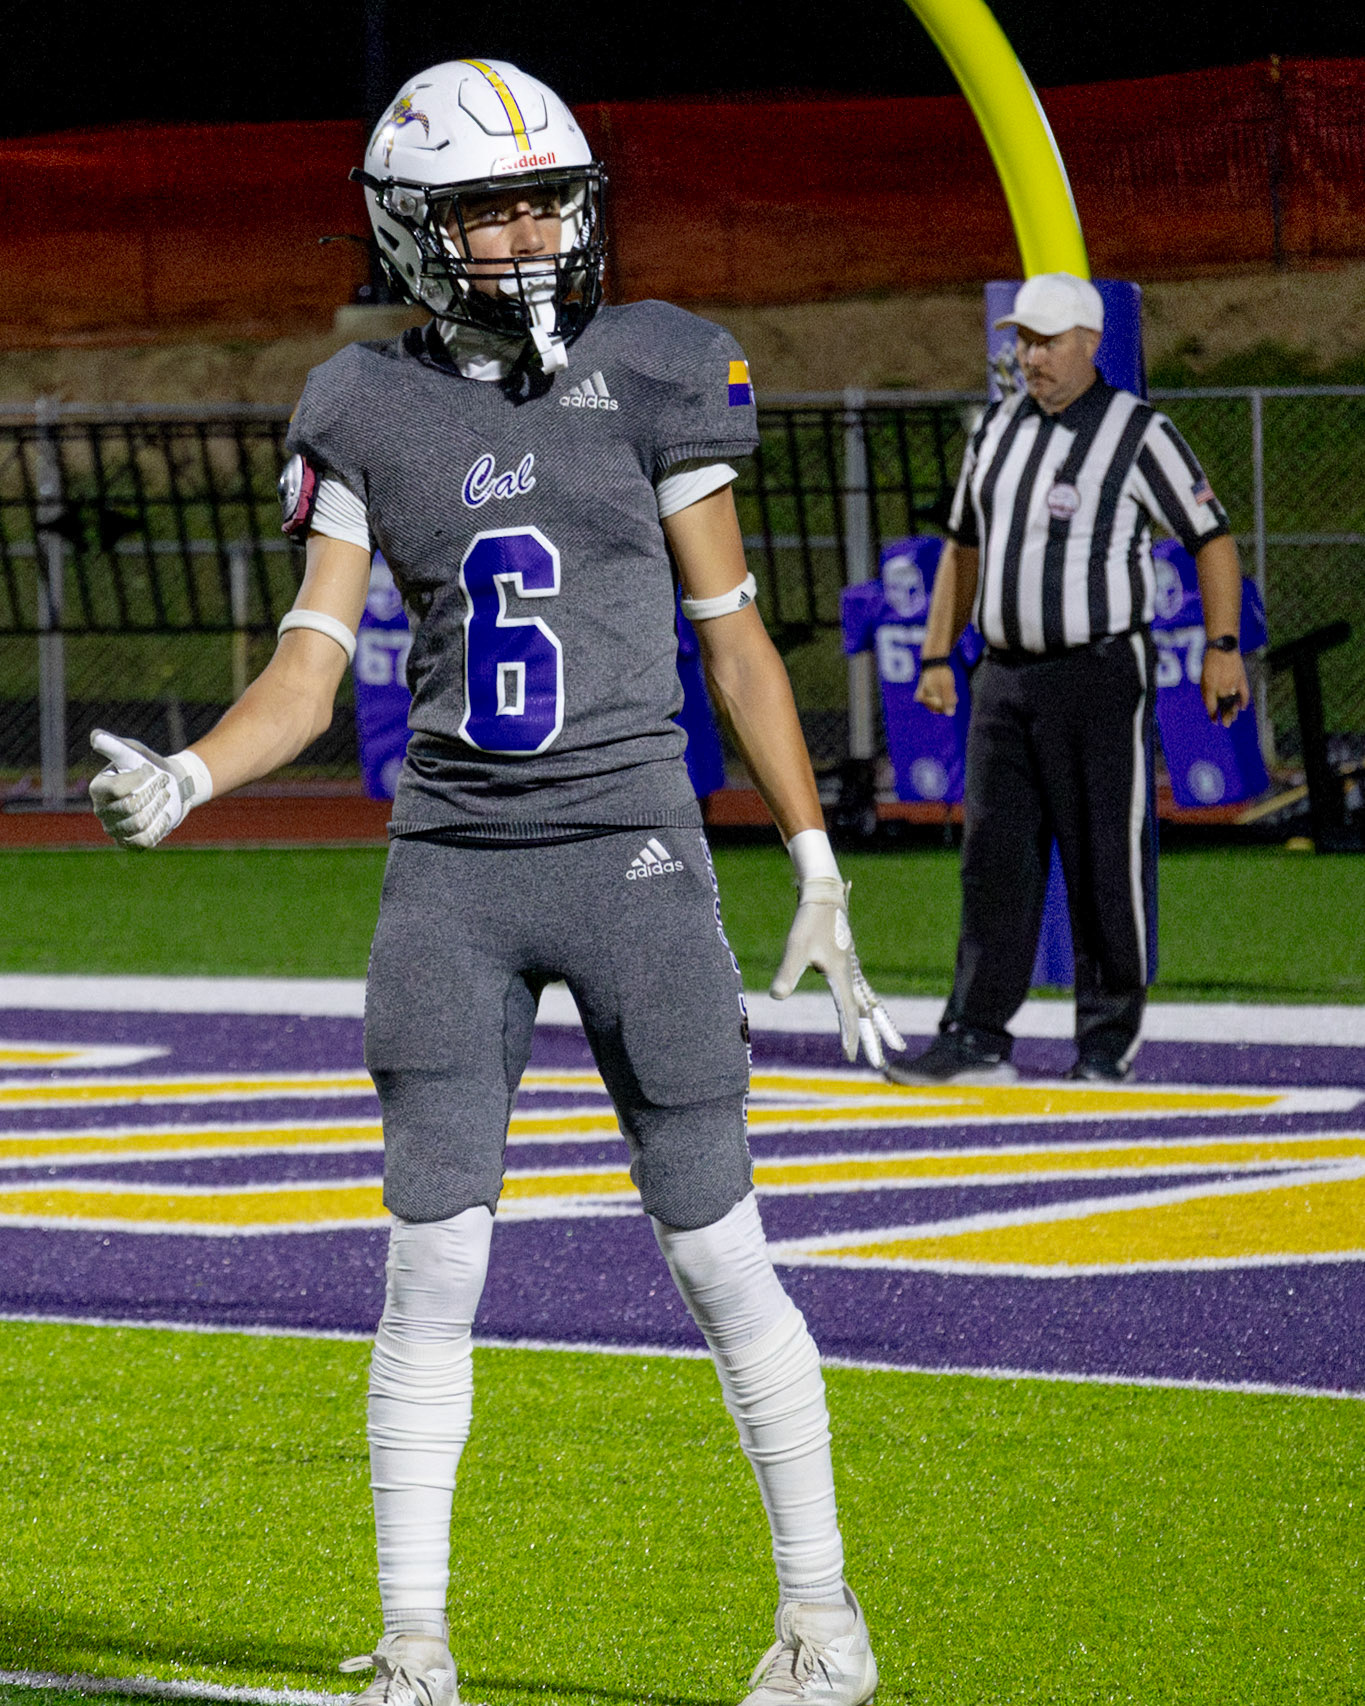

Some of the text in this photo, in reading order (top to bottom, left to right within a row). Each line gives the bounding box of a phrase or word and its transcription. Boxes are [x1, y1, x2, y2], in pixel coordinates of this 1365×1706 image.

[559, 393, 619, 411] adidas
[461, 453, 536, 509] Cal
[457, 525, 565, 756] 6
[876, 624, 927, 683] 6
[625, 860, 684, 880] adidas
